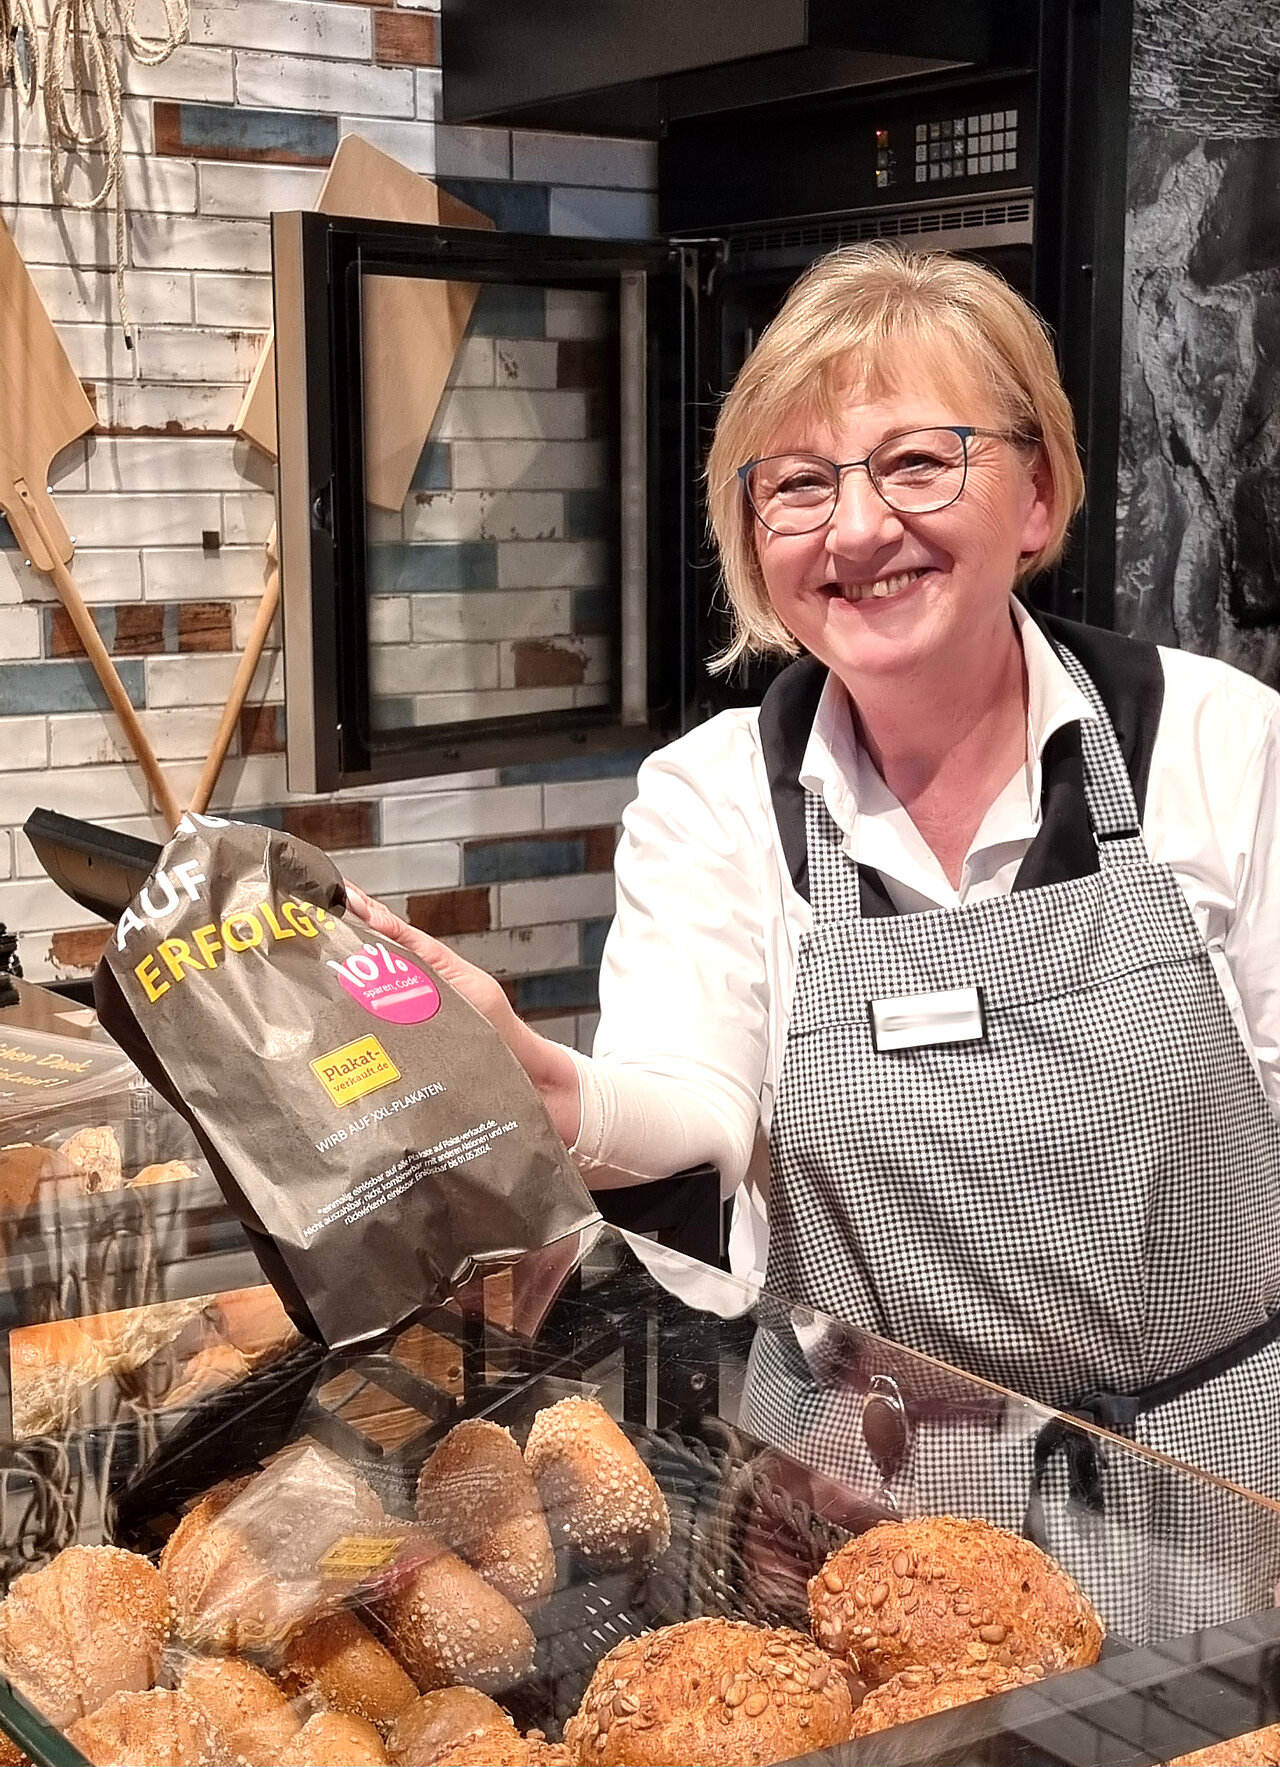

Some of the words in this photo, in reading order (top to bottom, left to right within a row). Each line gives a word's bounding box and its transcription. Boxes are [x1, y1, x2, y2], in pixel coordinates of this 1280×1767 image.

[116, 859, 206, 952] AUF
[134, 901, 336, 1003] ERFOLG?
[326, 942, 409, 988] 10%
[363, 983, 398, 999] sparen,
[322, 1050, 380, 1082] Plakat-
[333, 1061, 389, 1092] verkauft.de
[315, 1129, 348, 1153] WIRB
[349, 1115, 371, 1136] AUF
[370, 1081, 447, 1121] XXL-PLAKATEN.
[324, 1198, 365, 1225] auszahlbar,
[364, 1187, 382, 1202] nicht
[424, 1156, 437, 1167] mit
[437, 1147, 461, 1163] anderen
[461, 1134, 489, 1151] Aktionen
[488, 1126, 503, 1139] und
[344, 1195, 387, 1225] rückwirkend
[447, 1158, 458, 1169] bis
[352, 1173, 384, 1196] einlösbar
[385, 1164, 398, 1177] auf
[408, 1148, 433, 1163] Plakate
[433, 1141, 443, 1153] auf
